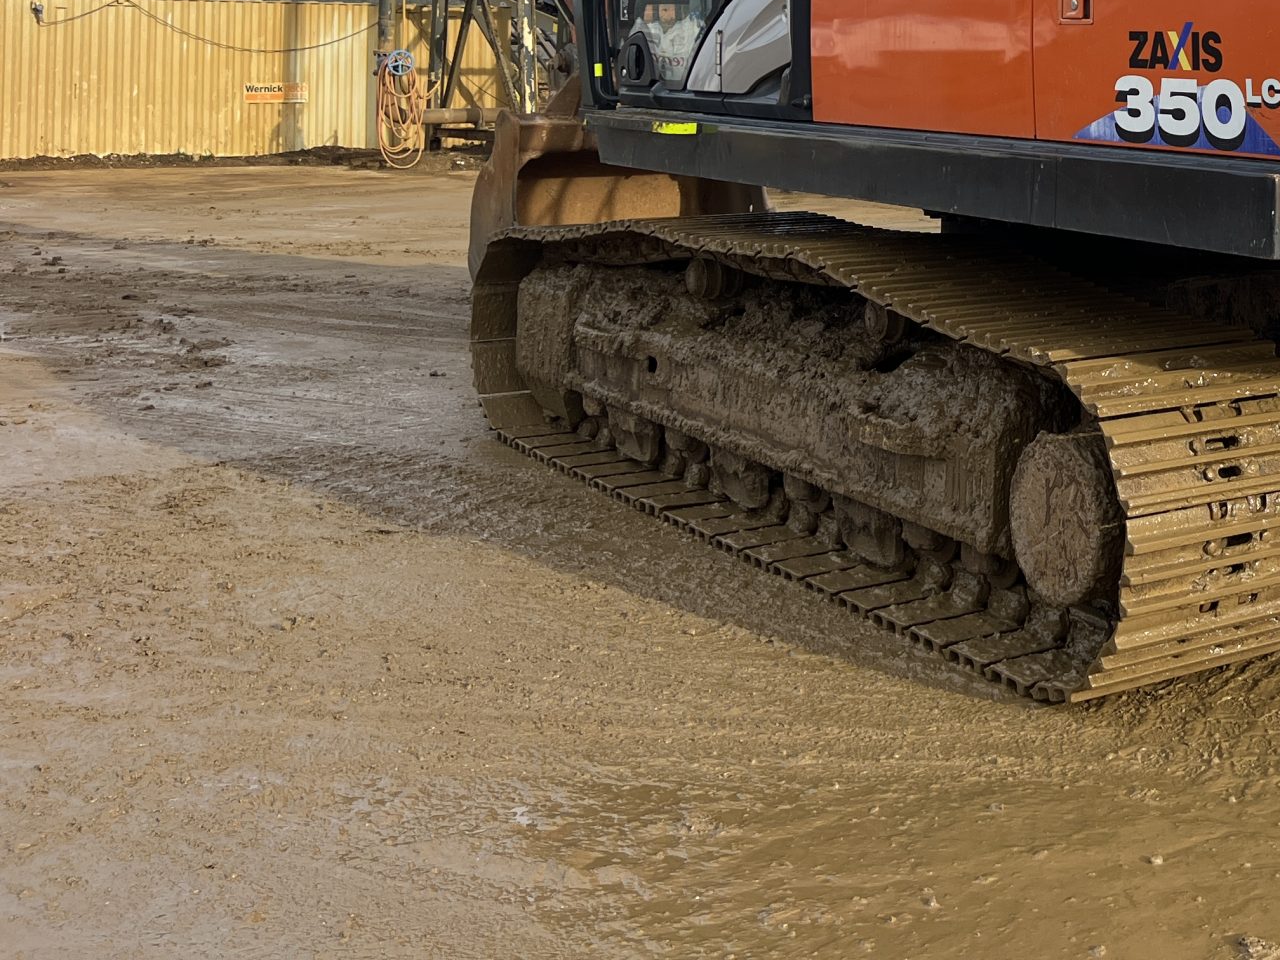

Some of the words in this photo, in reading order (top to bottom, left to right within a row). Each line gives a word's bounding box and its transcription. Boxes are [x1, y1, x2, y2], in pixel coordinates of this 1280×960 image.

[1129, 22, 1223, 72] ZAXIS
[245, 84, 284, 93] Wernick
[1114, 75, 1247, 149] 350
